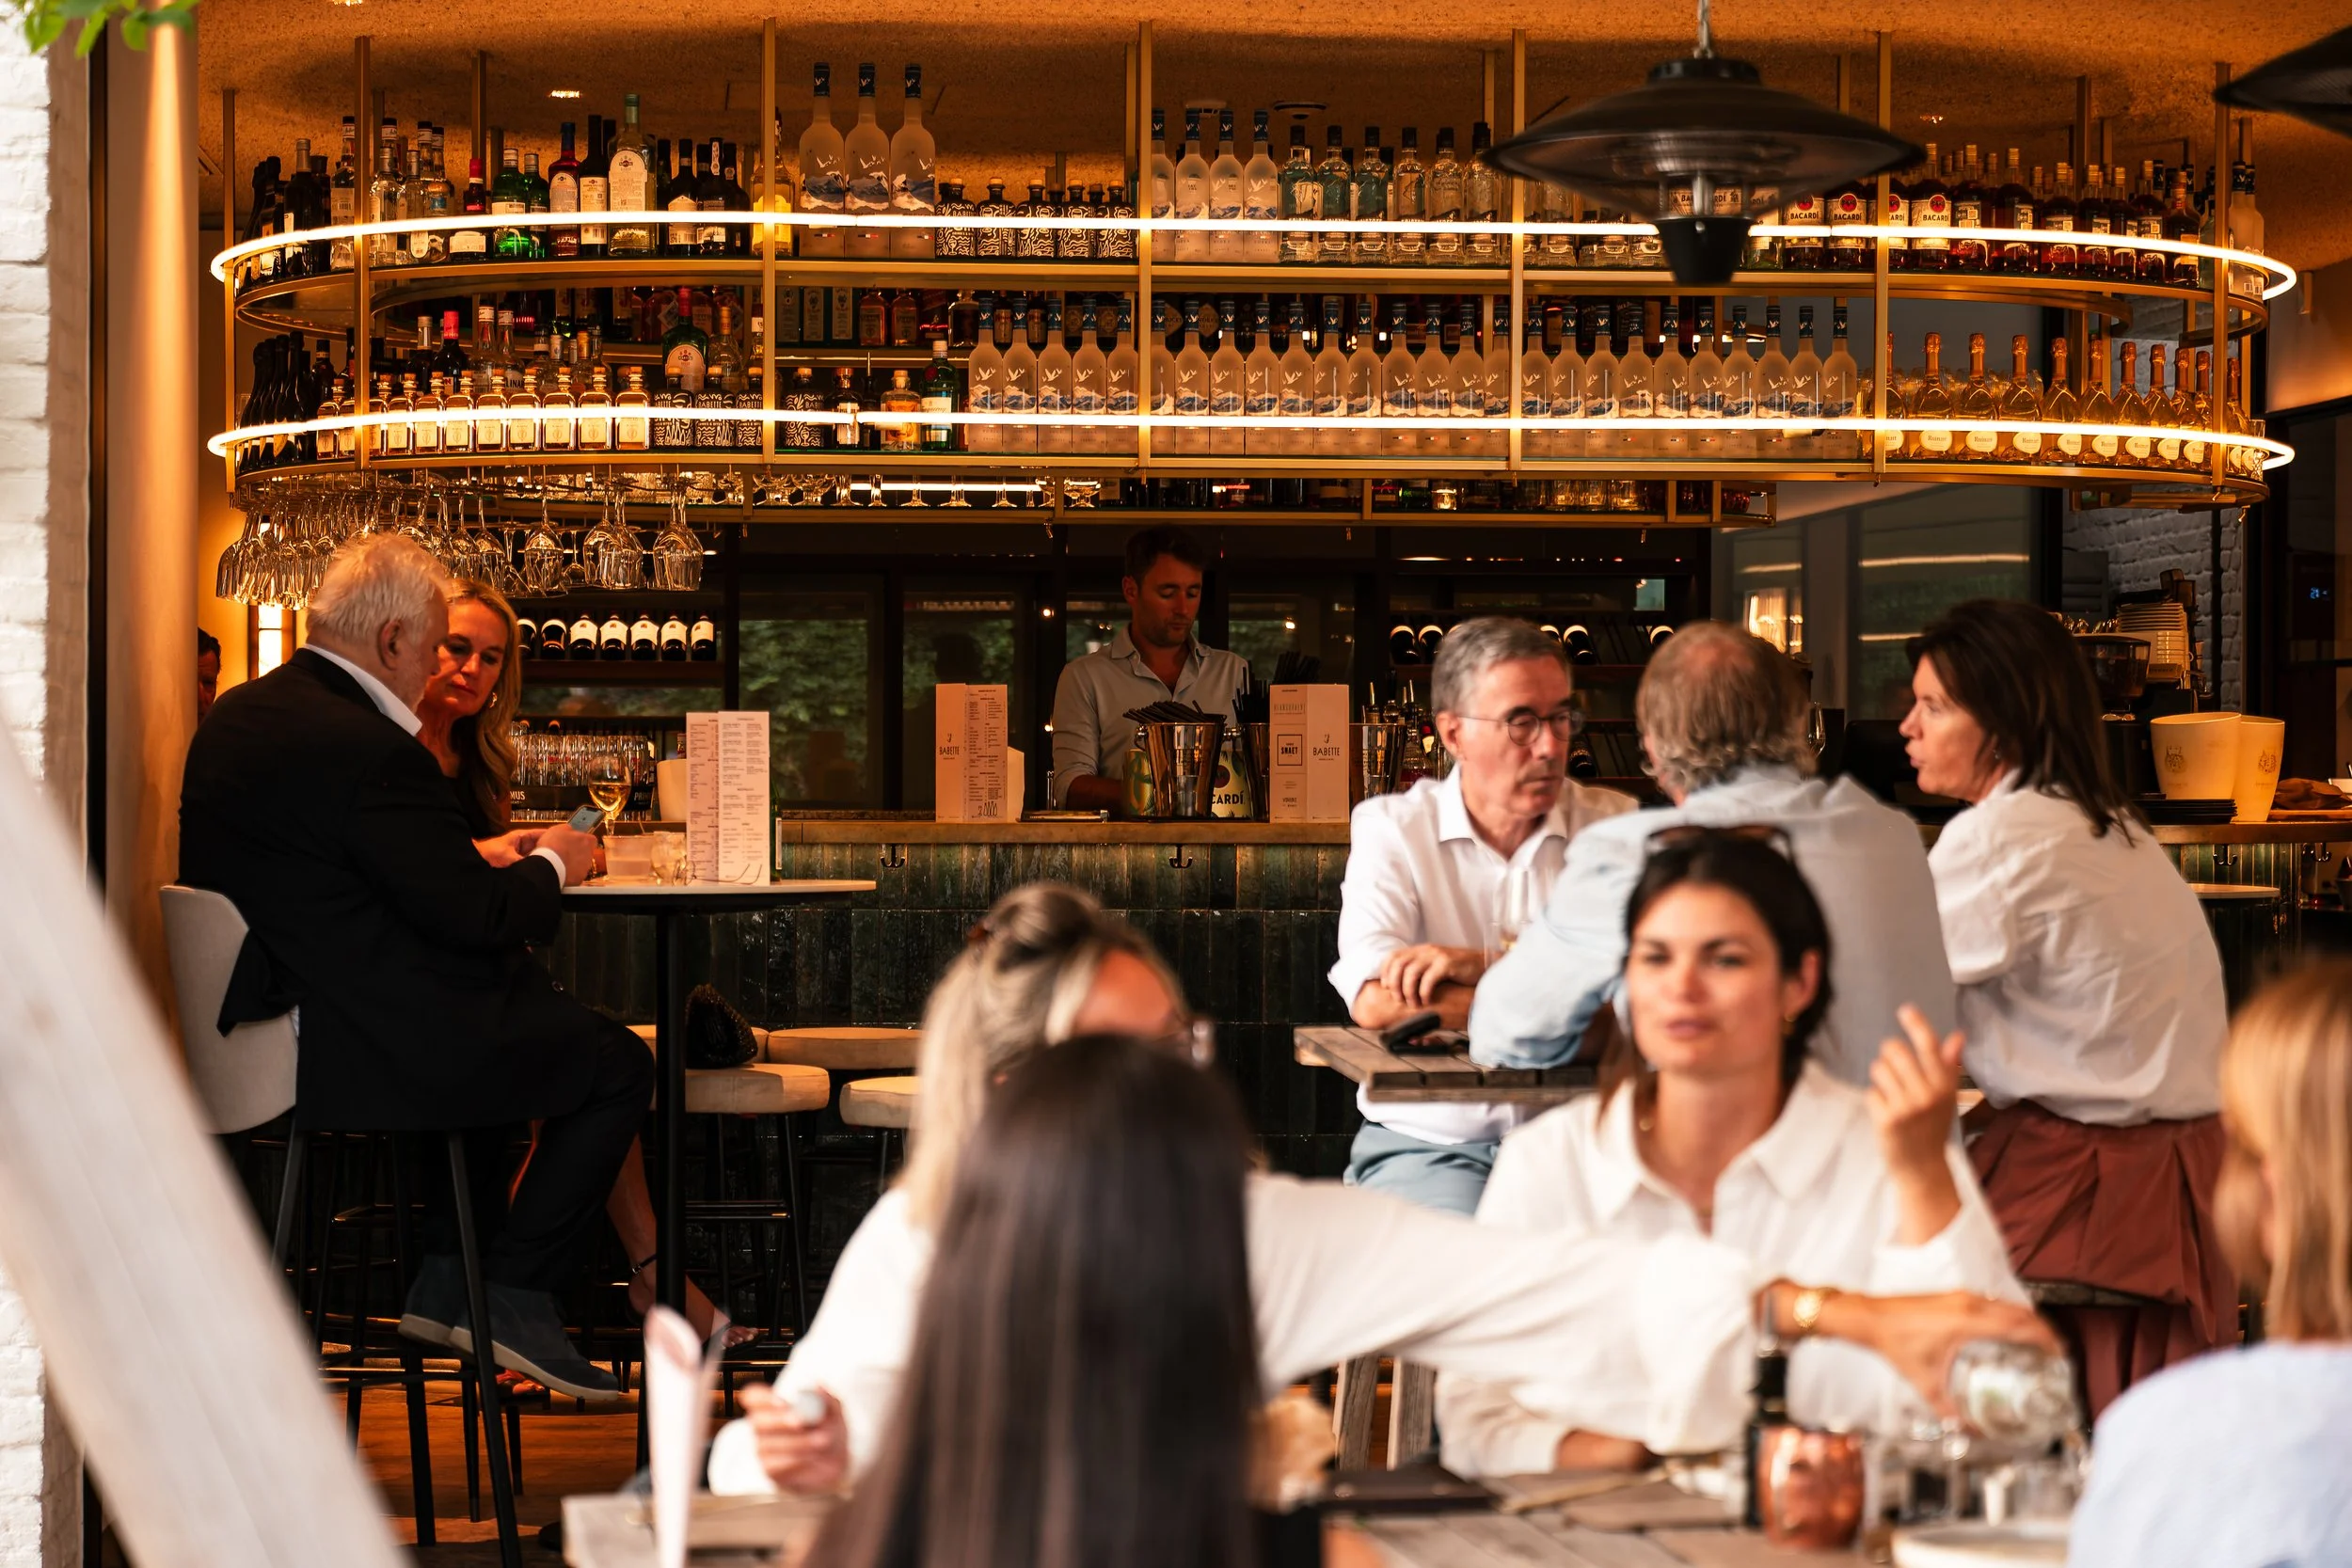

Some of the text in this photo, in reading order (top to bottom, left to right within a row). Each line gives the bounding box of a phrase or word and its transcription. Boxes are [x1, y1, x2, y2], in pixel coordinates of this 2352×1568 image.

[1790, 211, 1820, 220] BACARDÍ
[1834, 213, 1862, 221] BACARDÍ
[939, 746, 960, 755] BABETTE
[1312, 747, 1341, 756] BABETTE
